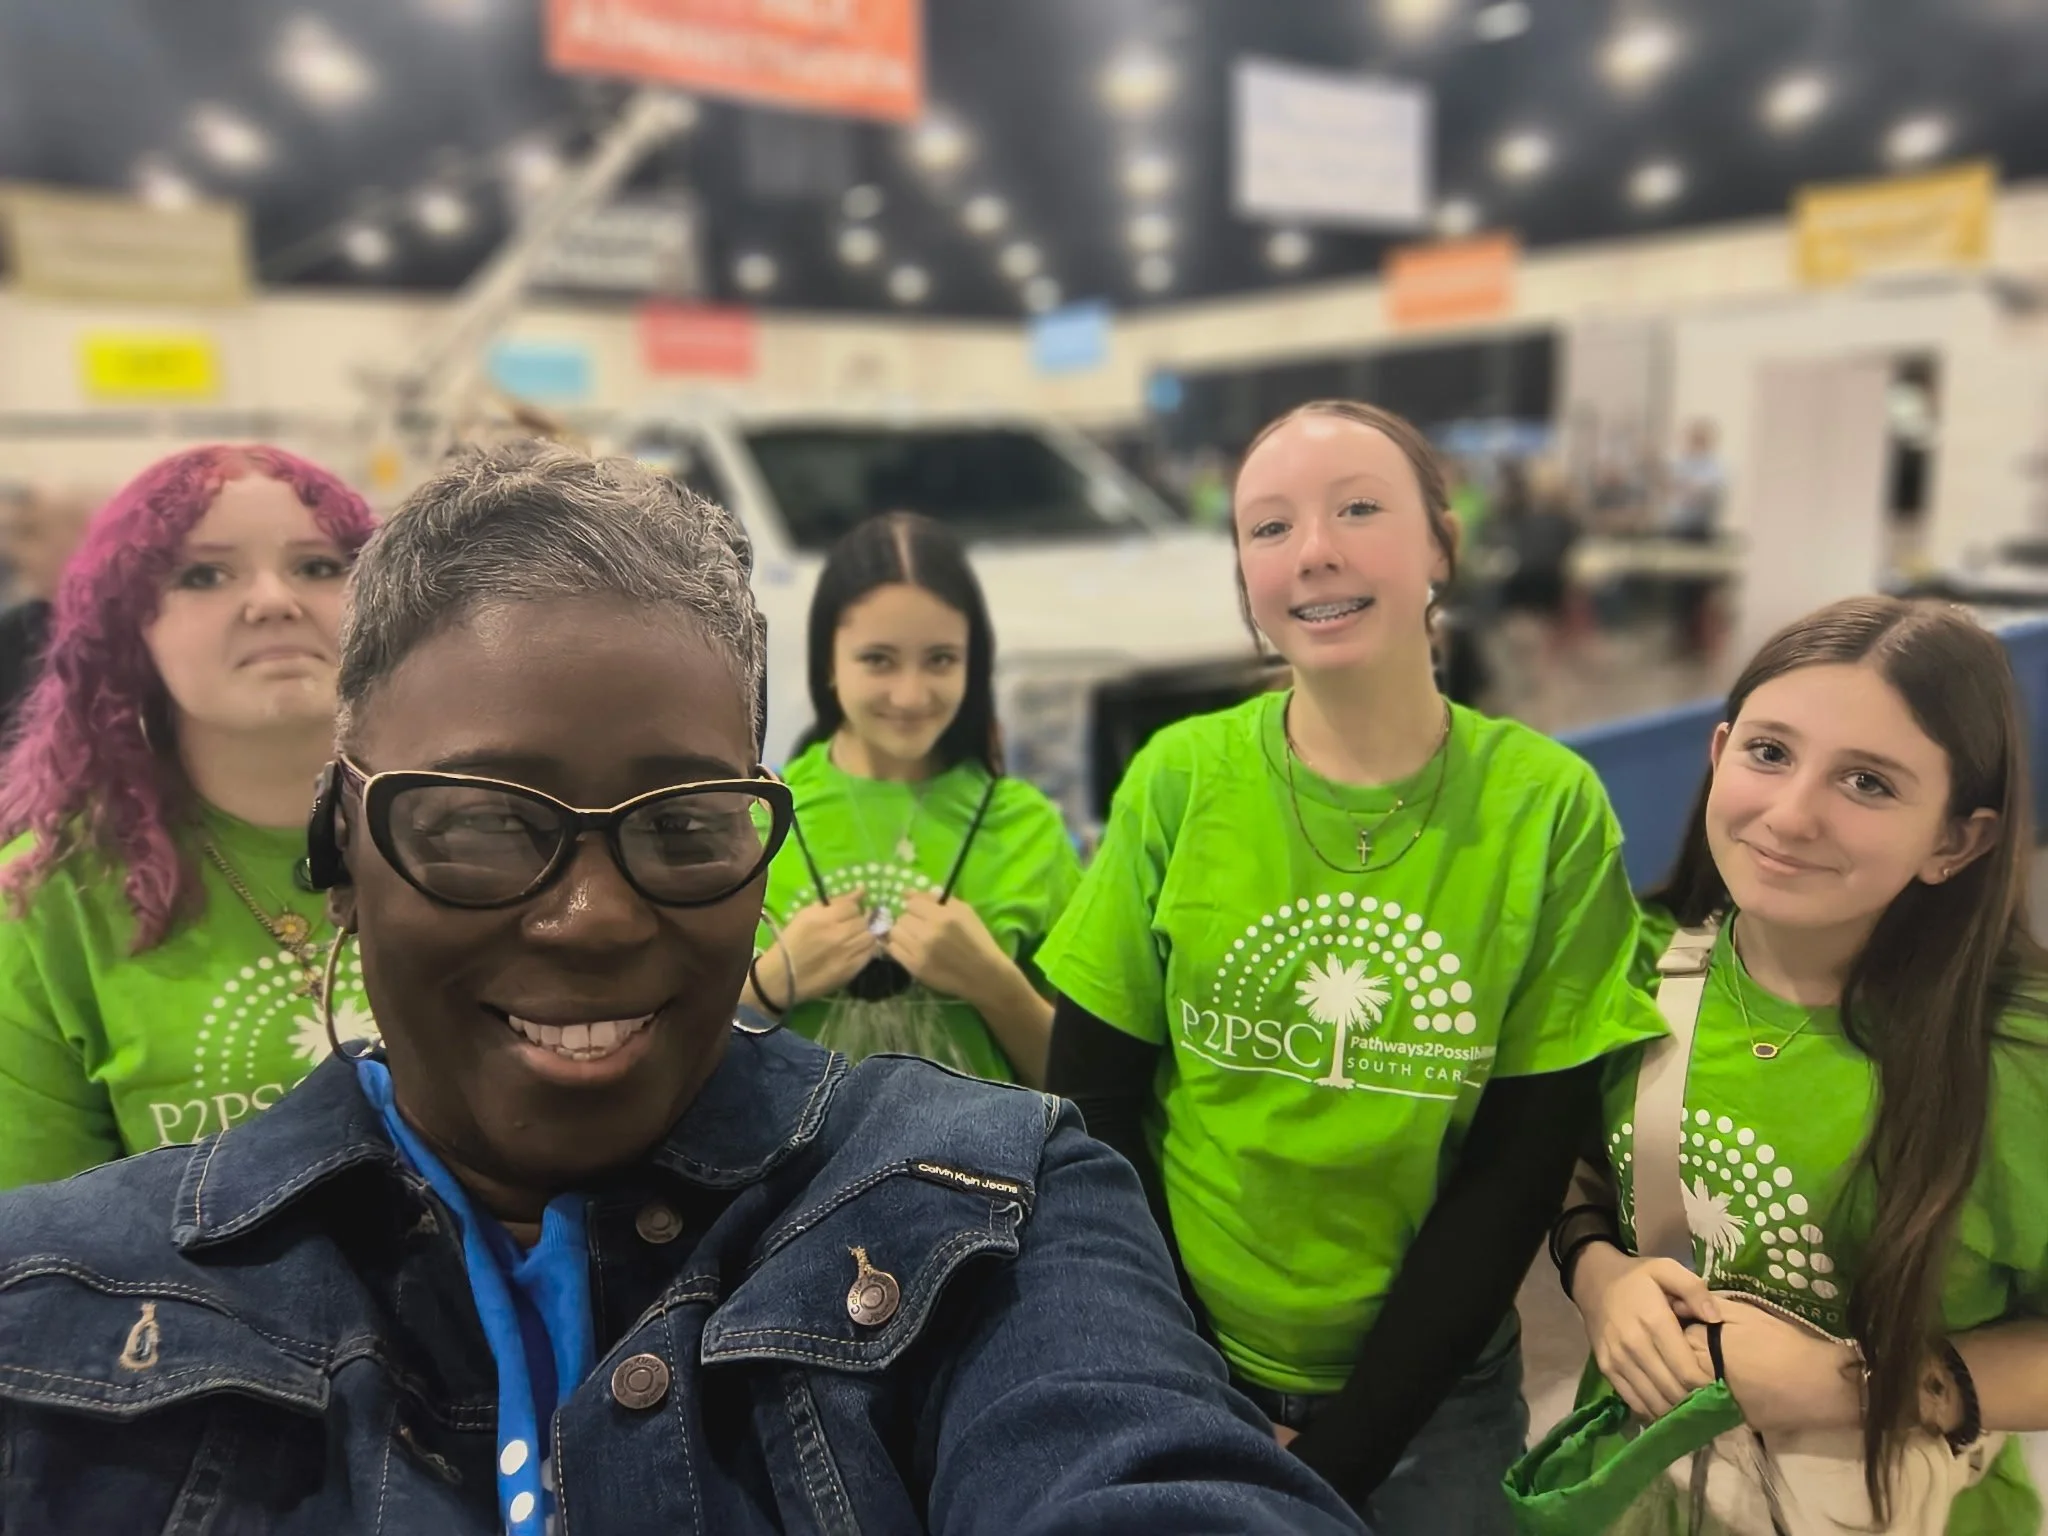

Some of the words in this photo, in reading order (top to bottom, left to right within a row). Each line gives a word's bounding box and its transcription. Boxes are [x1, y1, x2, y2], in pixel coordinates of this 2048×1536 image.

[1180, 998, 1323, 1068] P2PSC
[1346, 1056, 1412, 1076] SOUTH
[1424, 1065, 1464, 1083] CAR
[149, 1075, 307, 1146] P2PS
[918, 1163, 953, 1179] Calvin
[954, 1171, 980, 1187] Klein
[981, 1179, 1018, 1194] Jeans
